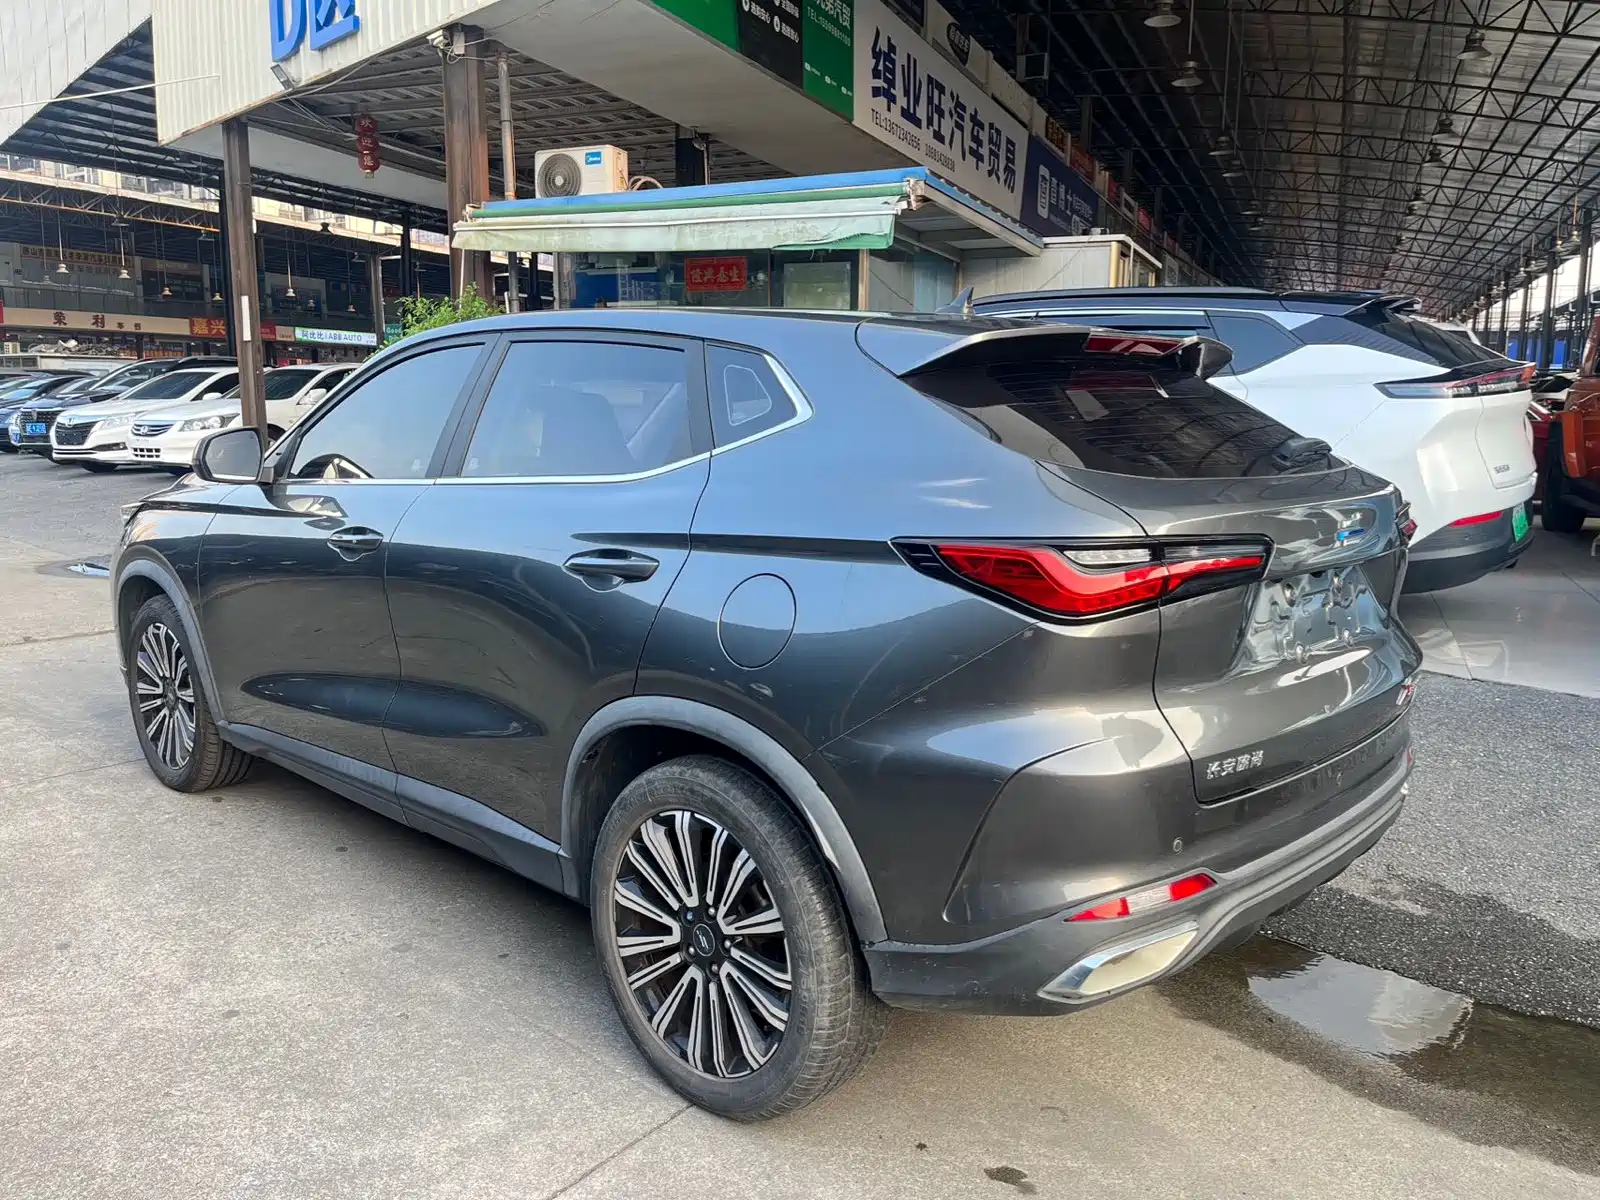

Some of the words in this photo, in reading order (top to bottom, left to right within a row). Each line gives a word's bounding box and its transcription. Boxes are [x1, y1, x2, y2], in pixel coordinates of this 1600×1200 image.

[871, 25, 1016, 194] 绰业旺汽车贸易
